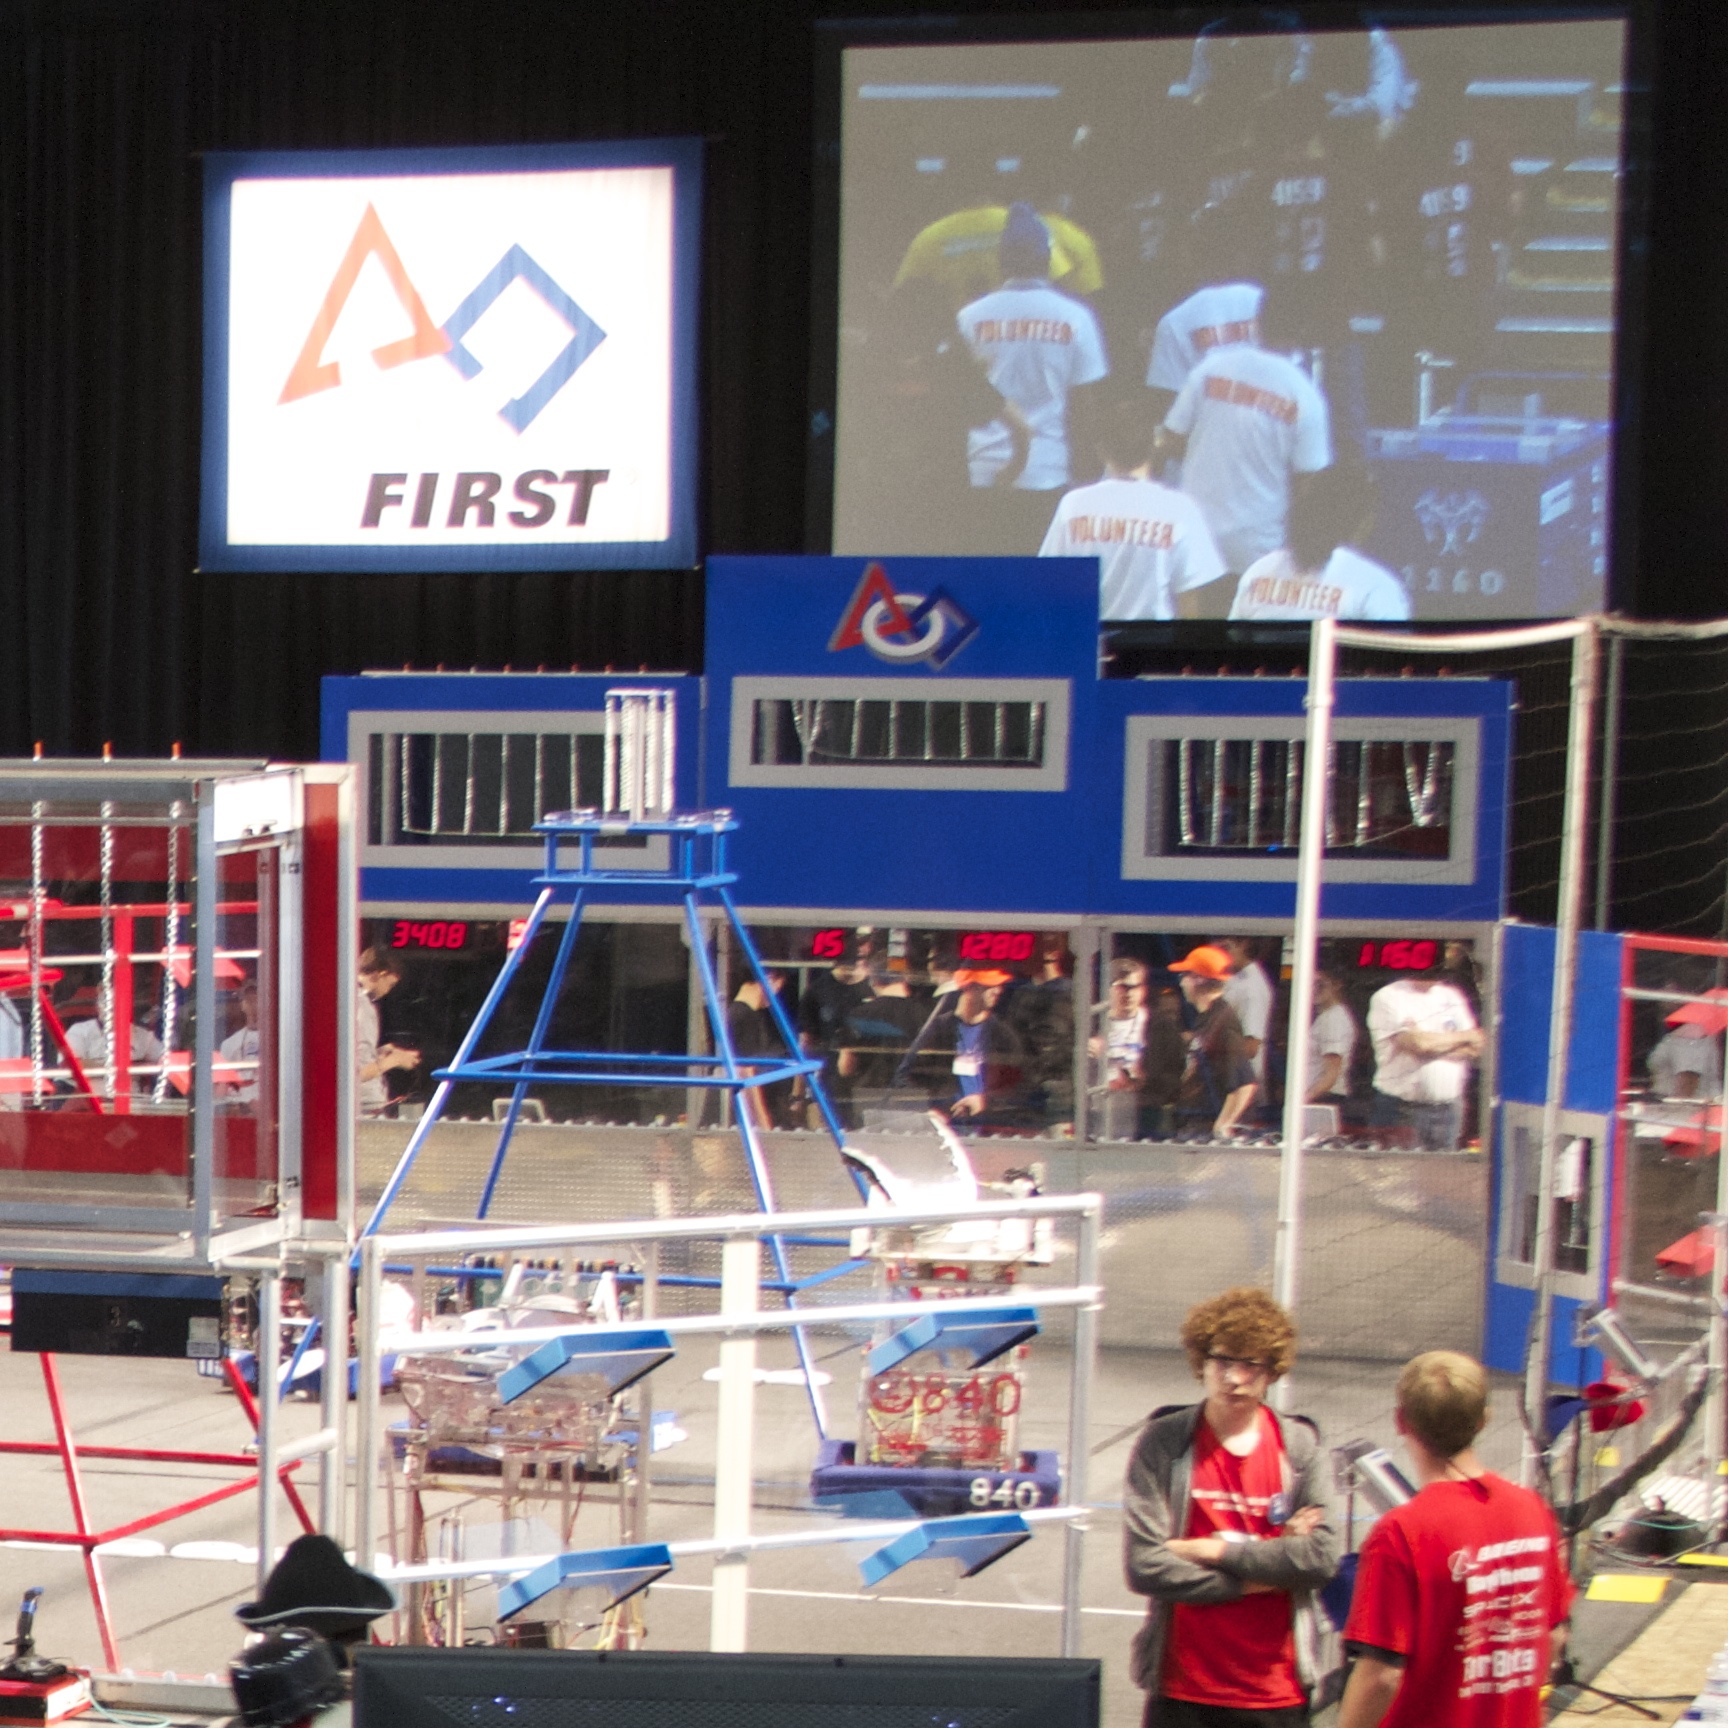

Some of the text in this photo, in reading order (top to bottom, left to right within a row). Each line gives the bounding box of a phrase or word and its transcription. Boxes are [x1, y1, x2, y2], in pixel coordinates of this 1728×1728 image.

[360, 468, 611, 529] FIRST
[1069, 515, 1176, 548] VOLUNTEER
[1249, 576, 1342, 615] VOLUNTEER
[391, 920, 467, 949] 3408
[960, 931, 1035, 961] 1280
[970, 1477, 1041, 1510] 840
